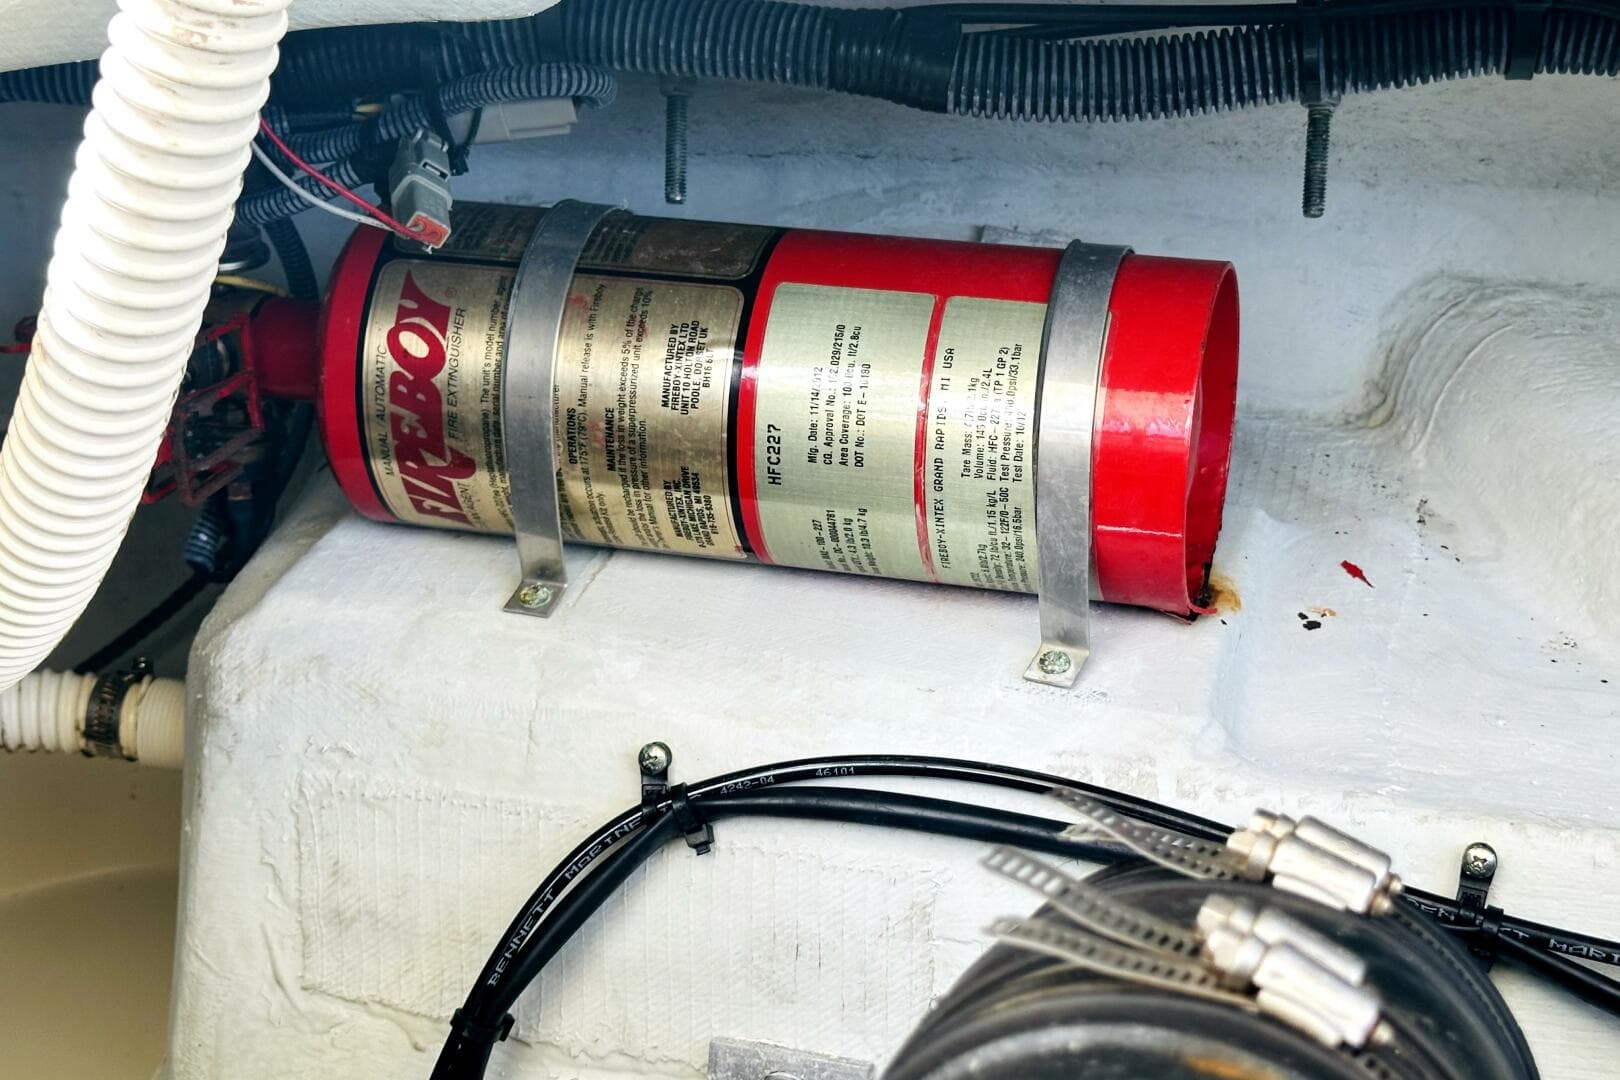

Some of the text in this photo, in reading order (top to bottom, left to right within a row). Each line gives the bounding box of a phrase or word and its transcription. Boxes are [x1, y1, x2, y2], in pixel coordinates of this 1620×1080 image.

[640, 289, 654, 307] 10%
[588, 313, 598, 331] with
[625, 314, 637, 328] the
[634, 310, 649, 343] exceeds
[584, 333, 593, 341] is
[623, 328, 633, 338] of
[699, 327, 709, 339] UK
[484, 333, 496, 360] model
[492, 341, 504, 357] and
[580, 342, 593, 373] release
[621, 340, 632, 355] 5%
[630, 344, 641, 361] unit
[828, 323, 846, 384] 12.029/215/0
[999, 346, 1010, 355] 2)
[661, 323, 679, 408] MANUFACTURED BY
[670, 322, 690, 411] FIREBOY-XINTEX LTD
[680, 320, 700, 415] UNIT 10 HOLTON ROAD
[942, 347, 955, 369] USA
[996, 357, 1007, 369] GP
[375, 344, 387, 421] AUTOMATIC
[447, 307, 466, 438] FIRE EXTINGUISHER
[481, 363, 492, 386] unit's
[617, 356, 630, 392] exceeds
[702, 365, 713, 388] BH16
[940, 376, 951, 391] MI
[387, 269, 477, 528] FIREBOY
[480, 389, 490, 404] The
[578, 375, 589, 407] Manual
[993, 380, 1004, 395] (TP
[616, 393, 627, 422] weight
[627, 363, 641, 438] superpressurized
[838, 401, 853, 445] Coverage:
[856, 408, 866, 426] DOT
[566, 407, 578, 464] OPERATIONS
[605, 407, 617, 472] MAINTENANCE
[615, 424, 624, 433] in
[808, 419, 819, 442] Date:
[823, 409, 837, 448] Approval
[616, 435, 626, 452] loss
[627, 446, 637, 456] of
[636, 418, 649, 469] information.
[962, 431, 973, 456] Mass:
[1000, 419, 1012, 461] Pressure:
[1013, 439, 1024, 461] Date:
[378, 432, 395, 477] MANUAL
[617, 453, 627, 466] the
[766, 424, 781, 485] HFC227
[808, 444, 819, 464] Mfg.
[838, 447, 849, 467] Area
[854, 450, 865, 468] DOT
[973, 443, 985, 479] Volume:
[580, 466, 590, 476] at
[628, 456, 643, 490] pressure
[680, 466, 691, 489] DRIVE
[933, 457, 944, 492] GRAND
[961, 459, 971, 478] Tare
[986, 455, 998, 481] Fluid:
[999, 463, 1009, 481] Test
[1012, 464, 1022, 483] Test
[619, 474, 634, 508] recharged
[640, 471, 651, 491] other
[663, 479, 672, 491] BY
[673, 477, 683, 493] INC.
[641, 492, 652, 503] for
[684, 490, 698, 523] MICHIGAN
[694, 495, 703, 505] MI
[985, 490, 997, 508] kg/L
[663, 491, 683, 538] MANUFACTURED
[857, 508, 868, 516] kg
[688, 522, 702, 536] LAKE
[934, 498, 951, 569] FIREBOY-XINTEX
[815, 766, 856, 777] 46101
[719, 774, 776, 796] 4242-04
[487, 816, 644, 987] BENNETT MARINE
